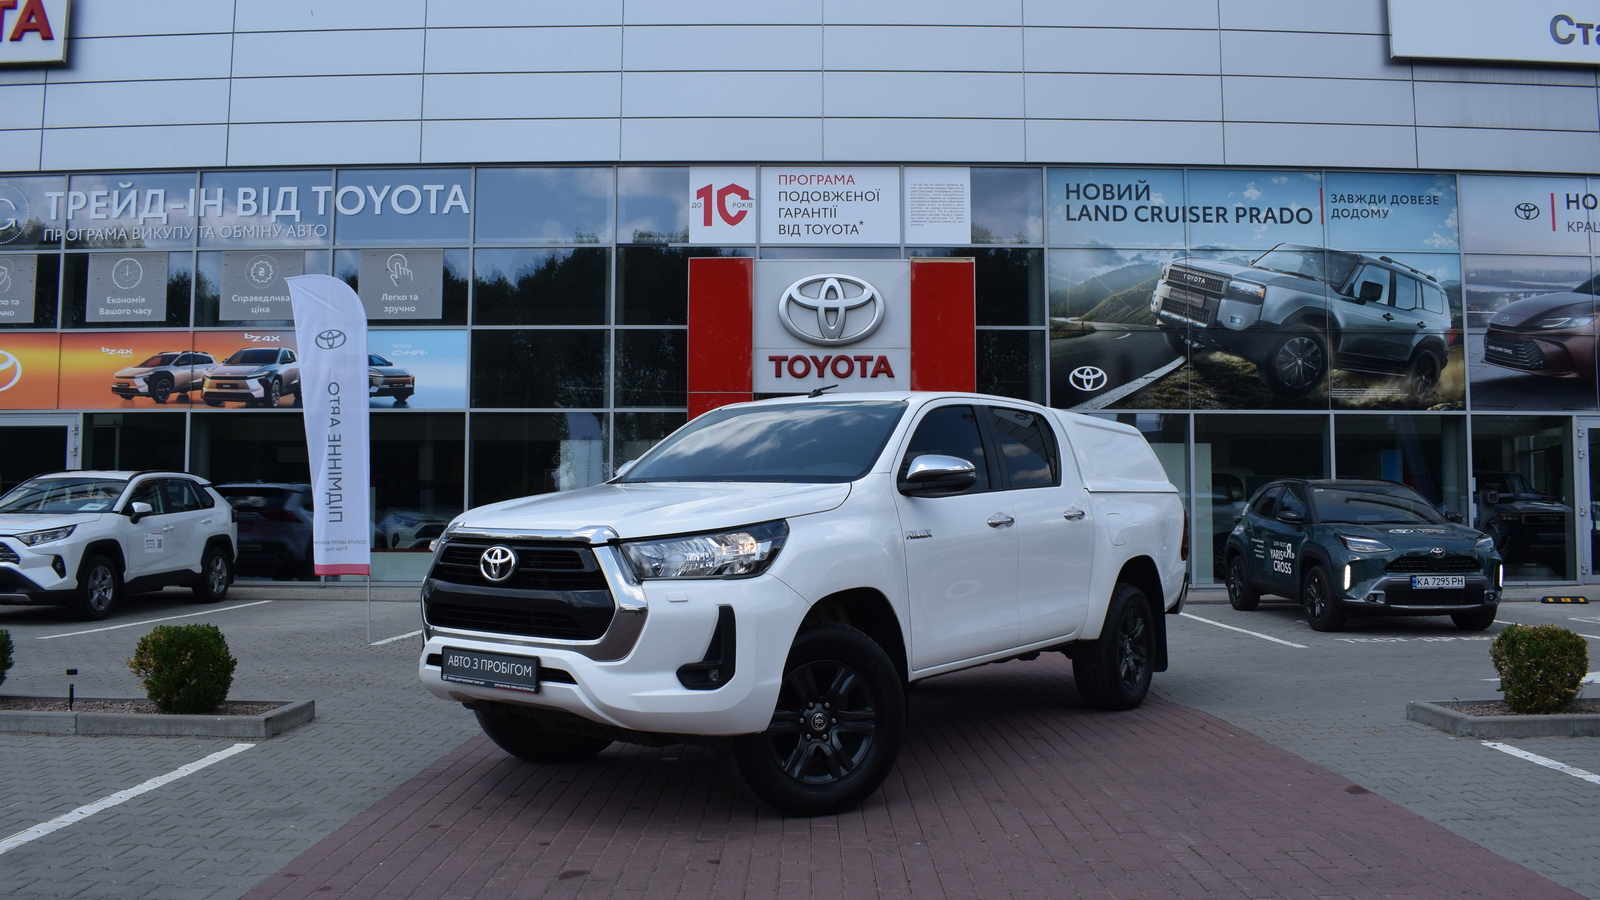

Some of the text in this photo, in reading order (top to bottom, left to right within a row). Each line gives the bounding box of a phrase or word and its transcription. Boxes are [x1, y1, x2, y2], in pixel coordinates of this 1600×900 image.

[1549, 14, 1600, 46] Ст
[778, 174, 856, 186] ПРОГРАМА
[778, 188, 881, 204] ПОДОВЖЕНОЇ
[1065, 180, 1150, 201] НОВИЙ
[44, 181, 470, 225] ТРЕЙД-ІН ВІД TOYOTA
[1330, 194, 1440, 206] ЗАВЖДИ ДОВЕЗЕ
[778, 205, 838, 219] ГАРАНТІЇ
[1065, 204, 1313, 225] LAND CRUISER PRADO
[1330, 208, 1390, 220] ДОДОМУ
[43, 224, 328, 242] ПРОГРАМА ВИКУПУ ТА ОБМІНУ АВТО
[778, 224, 801, 237] ВІД
[1183, 274, 1205, 284] TOYOTA
[106, 296, 146, 304] Економія
[232, 294, 291, 303] Справедлива
[381, 293, 407, 302] Легко
[99, 307, 153, 316] Вашого часу
[251, 305, 270, 314] ціна
[383, 305, 416, 314] зручно
[768, 355, 895, 379] TOYOTA
[1273, 560, 1292, 575] CROSS
[1417, 577, 1464, 586] KA 7295 PH
[447, 655, 471, 669] АВТО
[480, 659, 532, 677] ПРОБІГОМ
